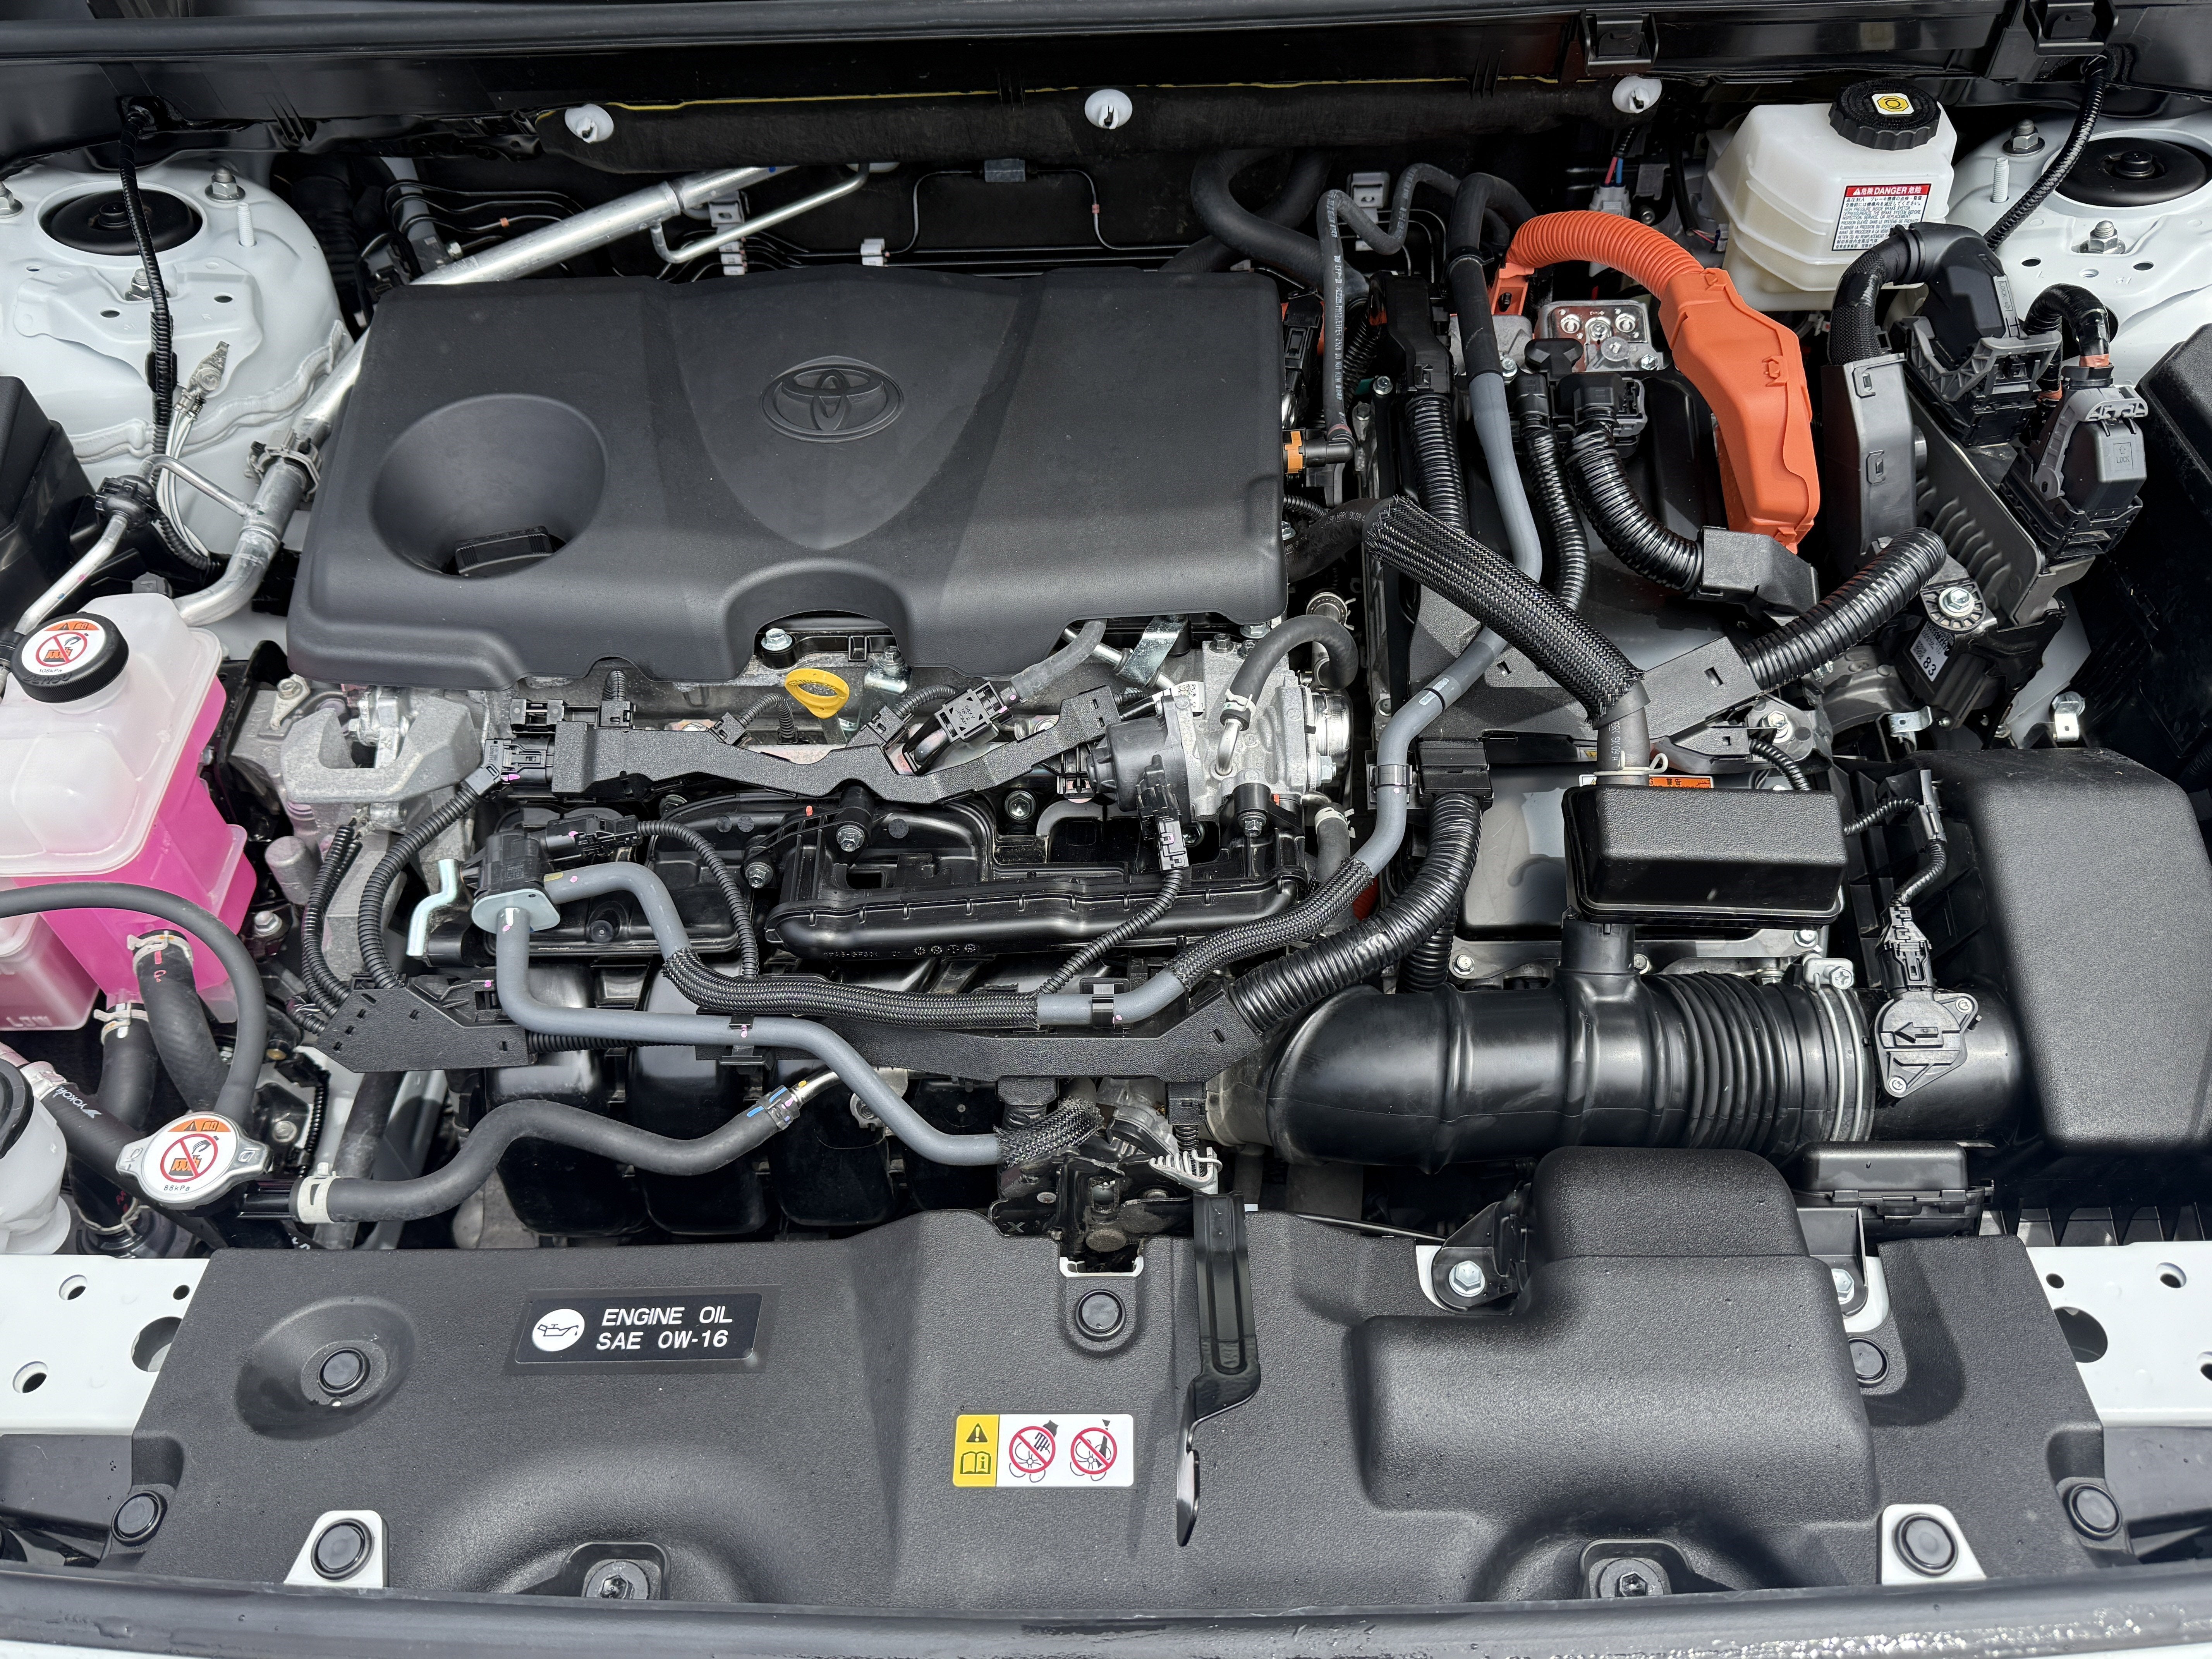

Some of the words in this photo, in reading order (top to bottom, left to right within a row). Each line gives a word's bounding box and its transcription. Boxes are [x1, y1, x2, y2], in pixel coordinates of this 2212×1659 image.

[1999, 282, 2008, 297] LOCK
[1923, 656, 1936, 676] 83
[6, 1016, 53, 1027] LOW
[601, 1306, 685, 1326] ENGINE
[699, 1305, 733, 1324] OIL
[596, 1331, 644, 1351] SAE
